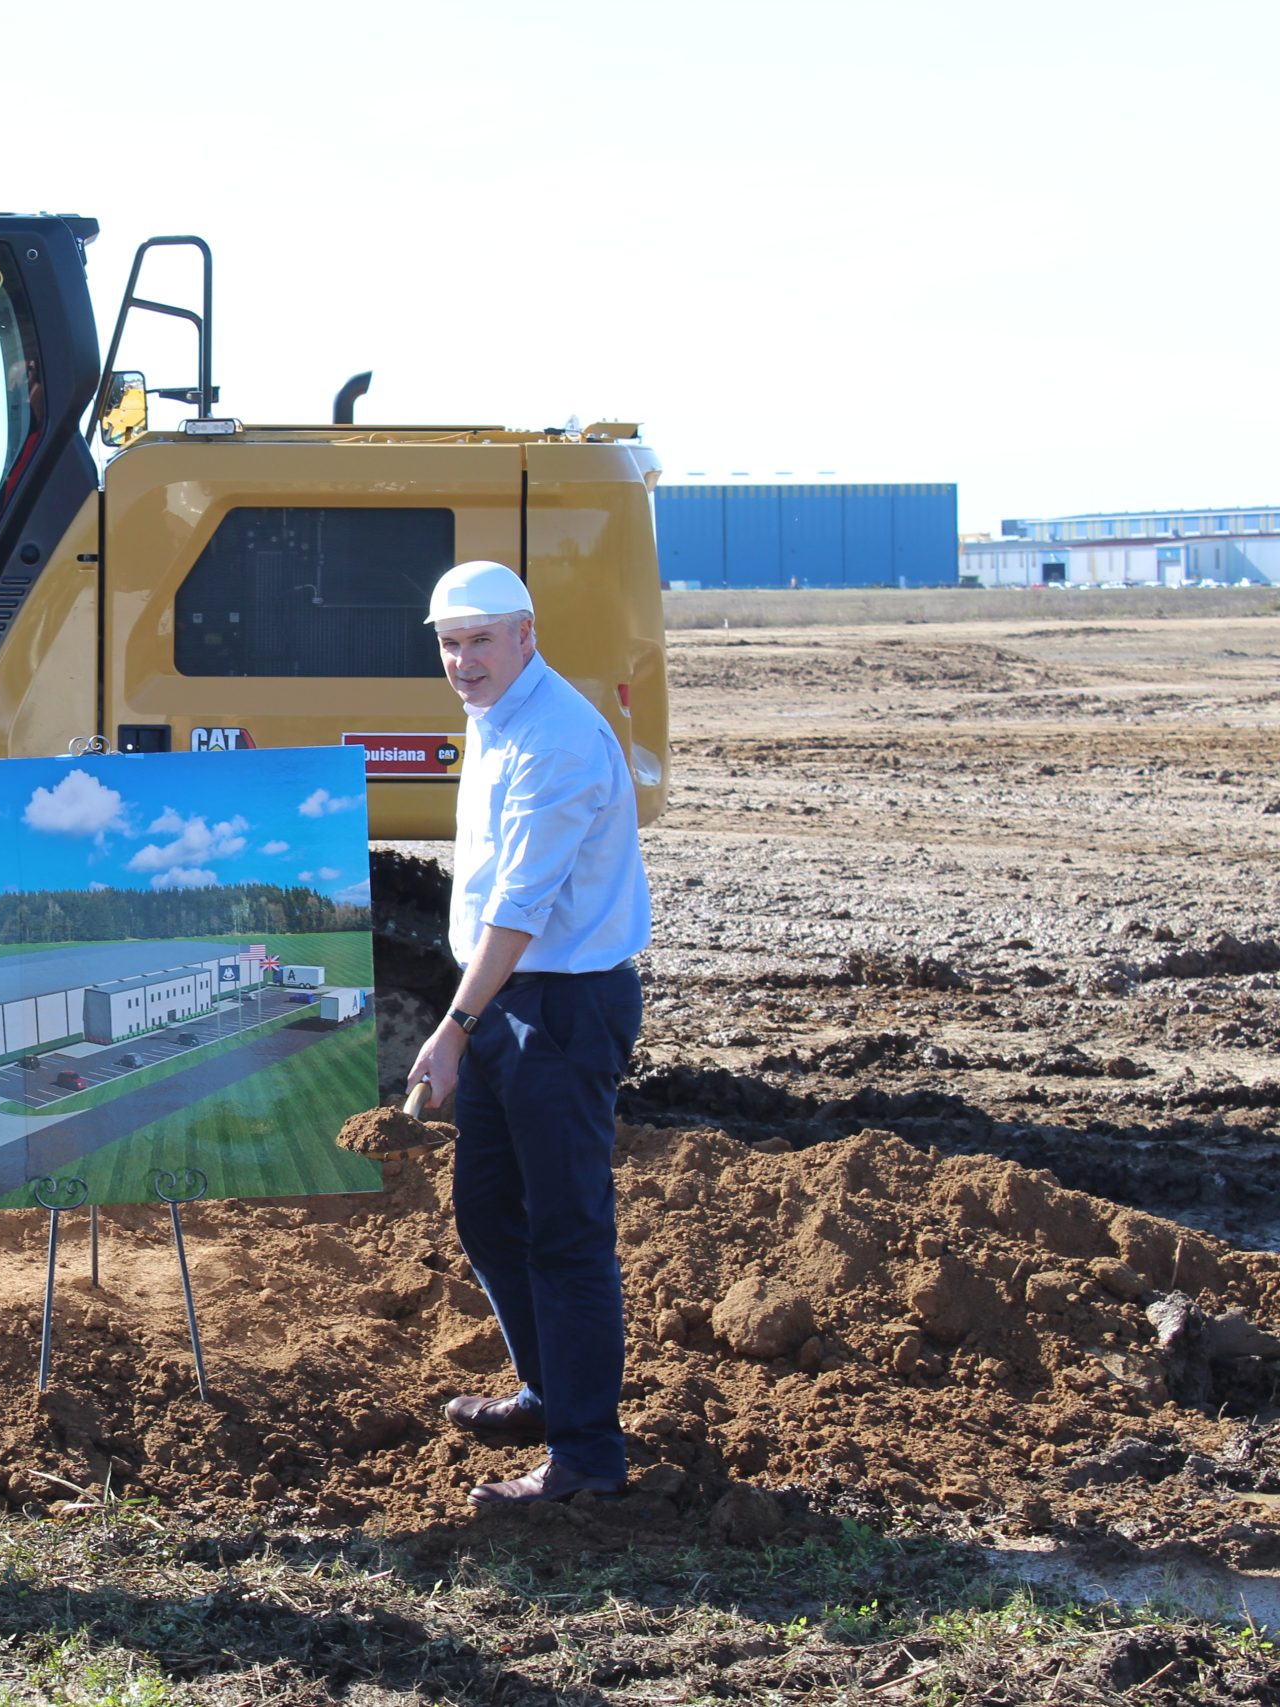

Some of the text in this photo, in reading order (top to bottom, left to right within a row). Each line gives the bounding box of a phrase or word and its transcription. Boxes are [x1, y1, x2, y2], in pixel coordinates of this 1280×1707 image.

[191, 727, 240, 752] CAT
[364, 746, 426, 761] ouisiana
[438, 749, 456, 760] CAT
[287, 969, 296, 981] A
